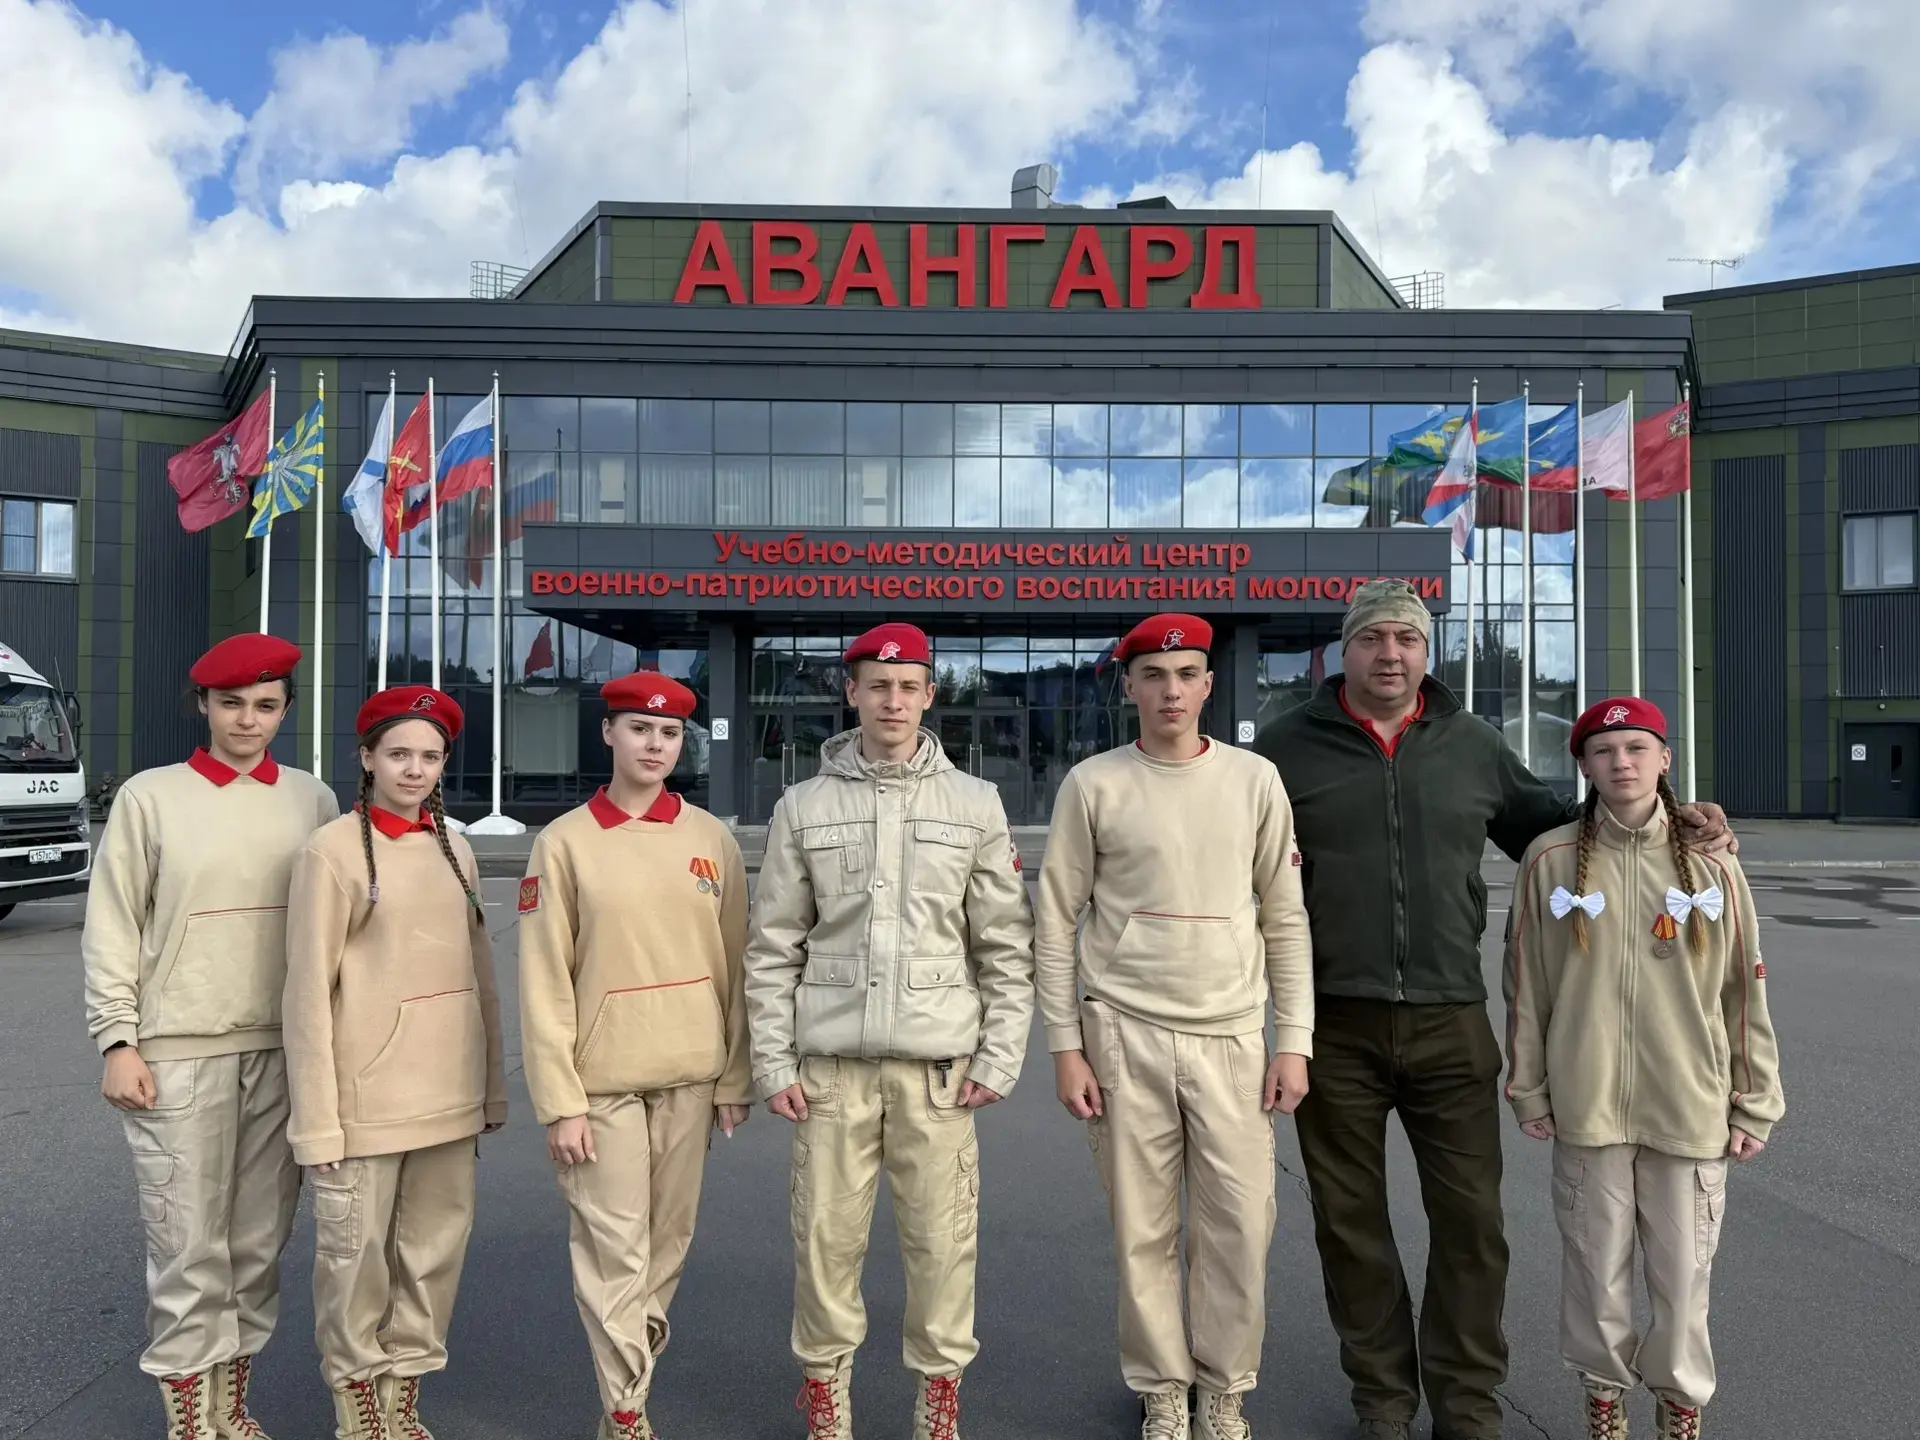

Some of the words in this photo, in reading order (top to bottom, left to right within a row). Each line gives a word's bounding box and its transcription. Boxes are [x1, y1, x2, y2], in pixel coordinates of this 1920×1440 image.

[673, 219, 1263, 309] АВАНГАРД
[713, 532, 1132, 570] Учебно-методический
[1143, 543, 1252, 574] центр
[531, 570, 1005, 605] военно-патриотического
[1016, 576, 1238, 601] воспитания
[26, 779, 60, 794] JAC
